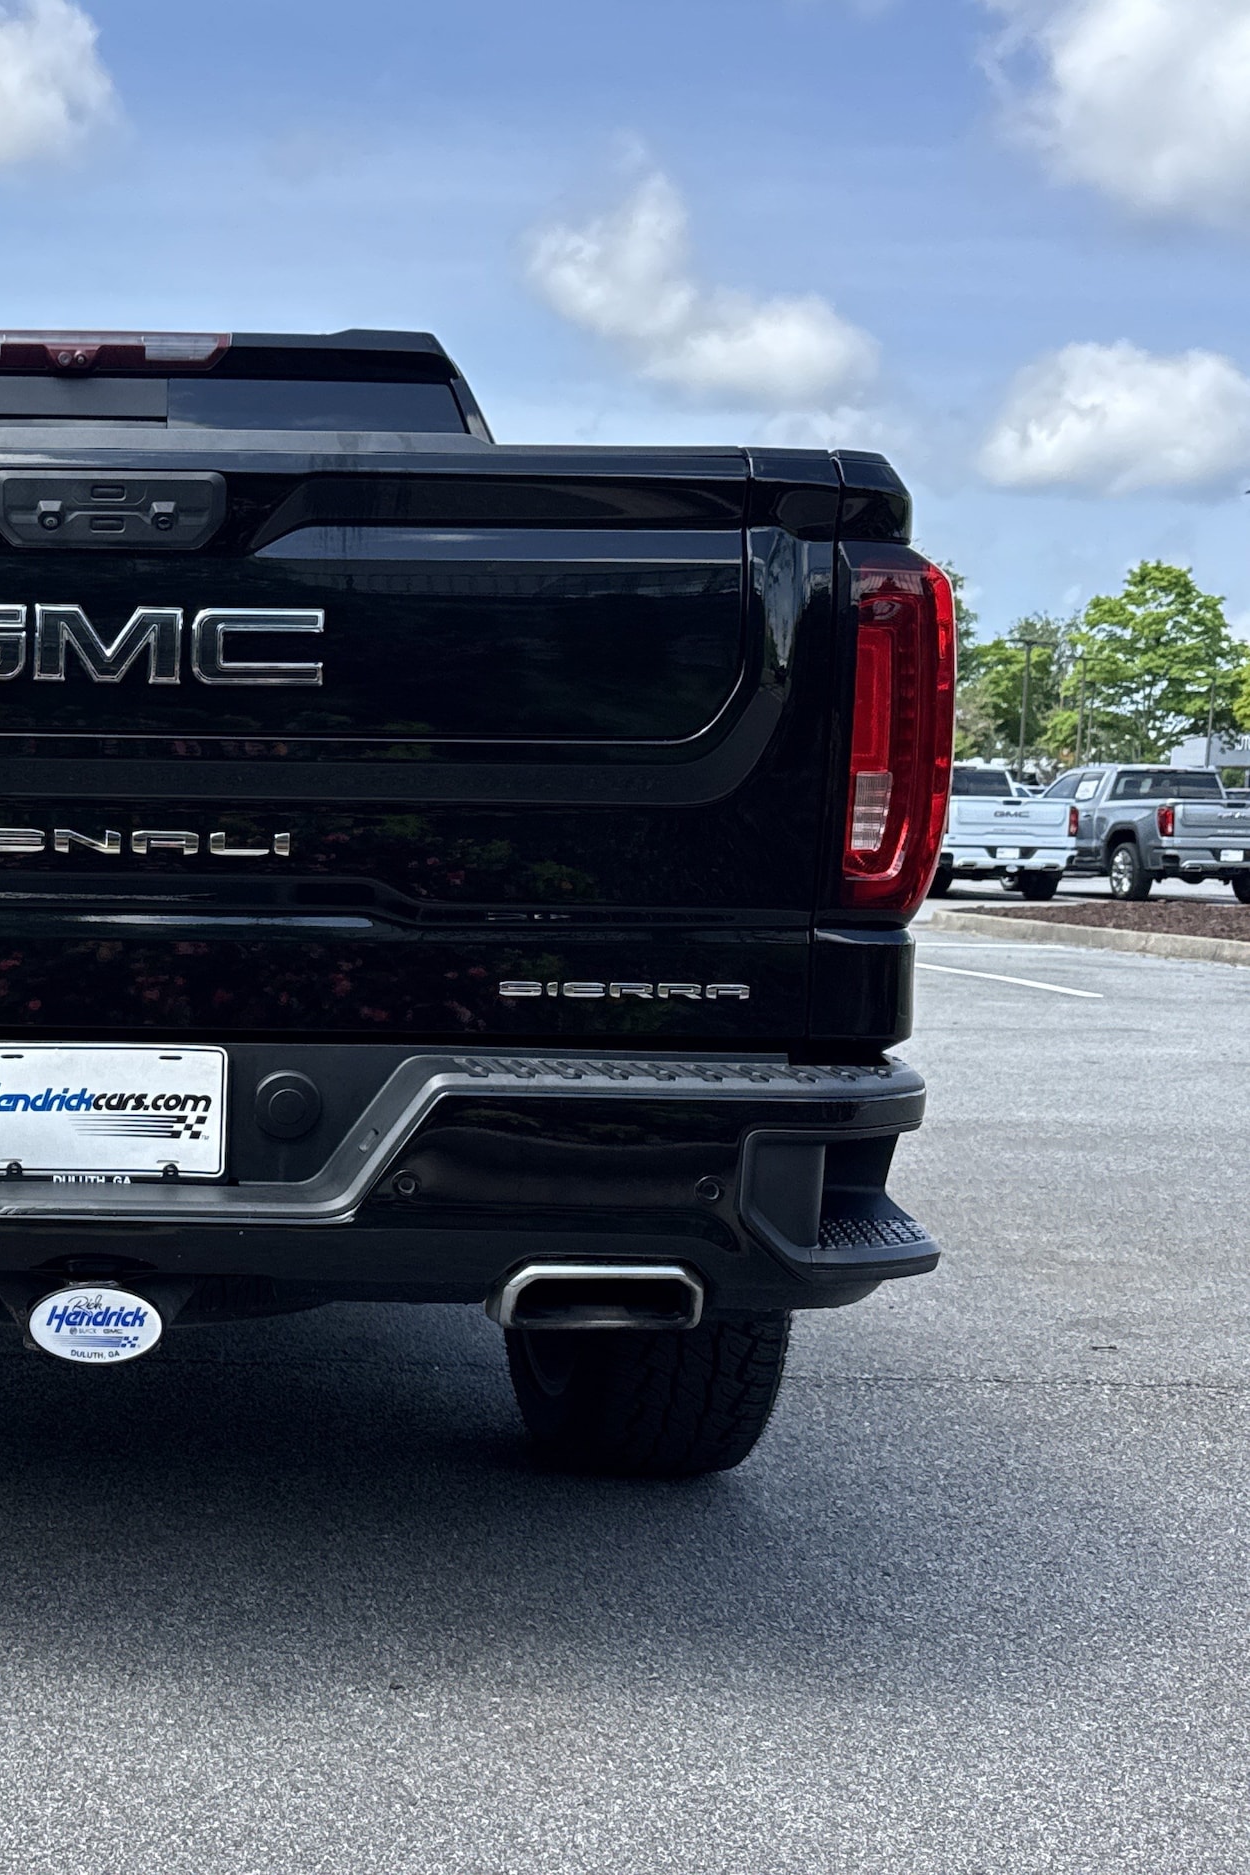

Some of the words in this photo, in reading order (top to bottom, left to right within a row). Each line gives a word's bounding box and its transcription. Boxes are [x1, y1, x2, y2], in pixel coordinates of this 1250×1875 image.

[993, 810, 1030, 818] GMC
[498, 980, 751, 1000] SIERRA
[113, 1176, 132, 1184] GA
[68, 1294, 103, 1312] Rick
[46, 1305, 148, 1333] Hendrick
[70, 1349, 107, 1360] DULUTH,
[108, 1350, 120, 1358] GA
